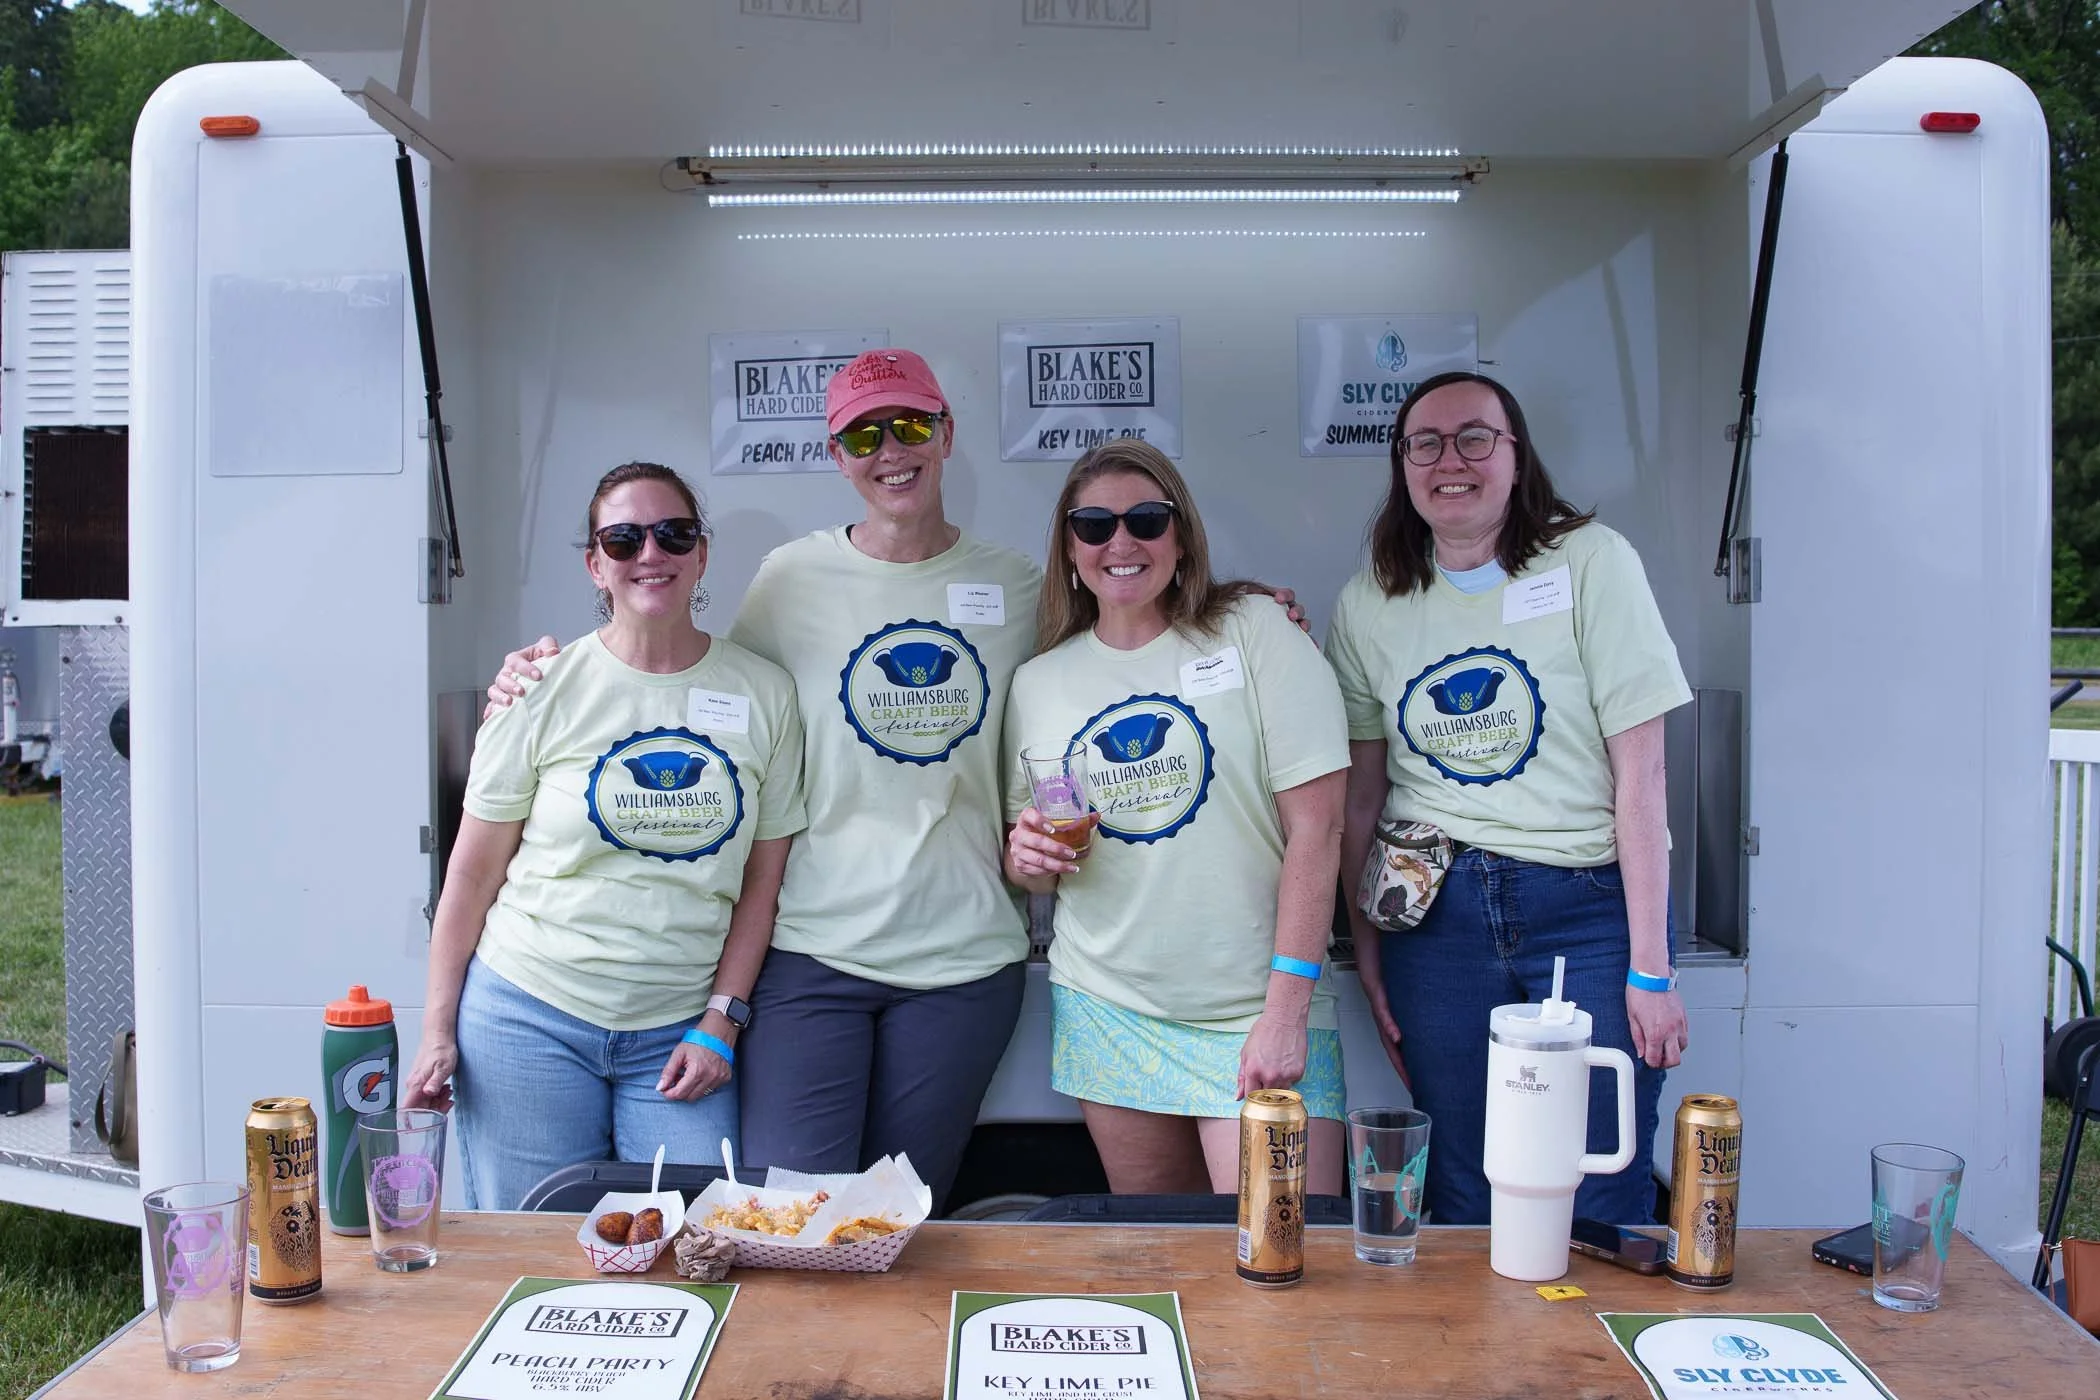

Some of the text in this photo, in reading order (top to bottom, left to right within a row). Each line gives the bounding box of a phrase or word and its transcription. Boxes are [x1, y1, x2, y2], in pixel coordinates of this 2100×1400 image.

[1038, 350, 1142, 382] BLAKE'S
[746, 364, 847, 396] BLAKE'
[1038, 384, 1080, 401] HARD
[1084, 382, 1126, 400] CIDER
[1342, 382, 1420, 403] SLY CLY
[746, 396, 827, 415] HARD CIDE
[1038, 429, 1070, 449] KEY
[1075, 428, 1114, 448] LIME
[742, 442, 795, 463] PEACH
[868, 689, 969, 708] WILLIAMSBURG
[870, 705, 969, 720] CRAFT BEER
[873, 716, 968, 733] festival
[1421, 709, 1517, 738] WILLIAMSBURG
[1427, 727, 1519, 750] CRAFT BEER
[1089, 755, 1187, 788] WILLIAMSBURG
[1096, 772, 1190, 800] CRAFT BEER
[614, 791, 722, 808] WILLIAMSBURG
[1101, 786, 1191, 814] festival
[616, 807, 724, 820] CRAFT BEER
[617, 819, 726, 834] festival
[342, 1056, 391, 1114] G
[1505, 1080, 1550, 1091] STANLEY
[544, 1308, 671, 1326] BLAKE'S
[538, 1320, 590, 1332] HARD
[594, 1323, 644, 1335] CIDER
[1004, 1327, 1130, 1342] BLAKE'S
[1004, 1340, 1055, 1350] HARD
[1060, 1341, 1111, 1351] CIDER
[491, 1352, 675, 1370] PEACH PARTY
[527, 1369, 589, 1377] BLACKBERRY
[575, 1377, 616, 1385] CIDER
[1673, 1368, 1847, 1384] SLY CLYDE
[984, 1375, 1158, 1390] KEY LIME PIE
